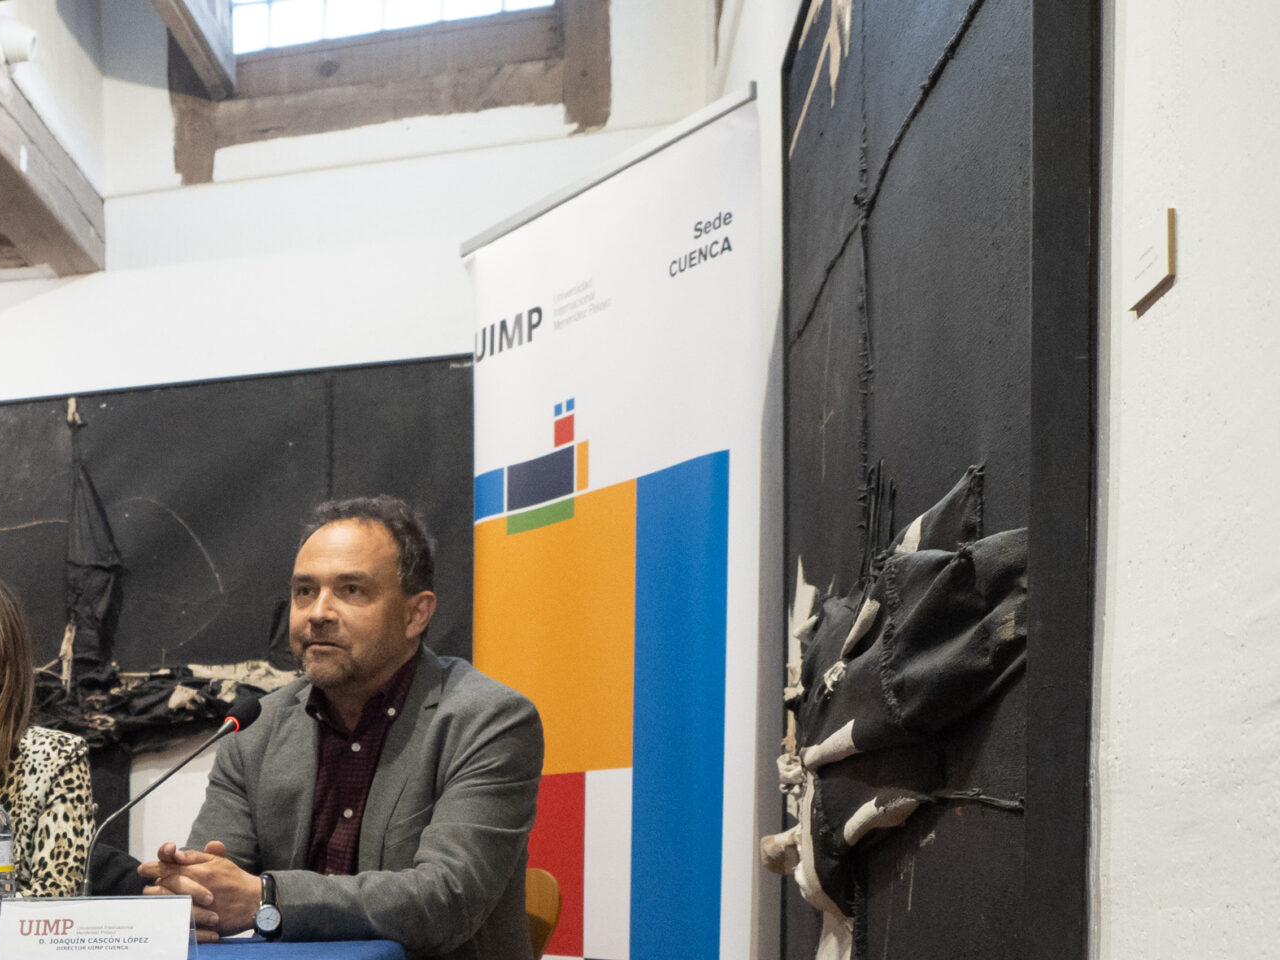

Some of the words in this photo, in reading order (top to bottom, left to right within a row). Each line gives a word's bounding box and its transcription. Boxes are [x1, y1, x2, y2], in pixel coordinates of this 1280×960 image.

[693, 211, 733, 239] Sede
[669, 236, 733, 277] CUENCA
[474, 306, 543, 363] UIMP
[19, 918, 75, 936] UIMP
[49, 936, 86, 946] JOAQUÍN
[87, 936, 121, 944] CASCÓN
[122, 936, 149, 944] LÓPEZ
